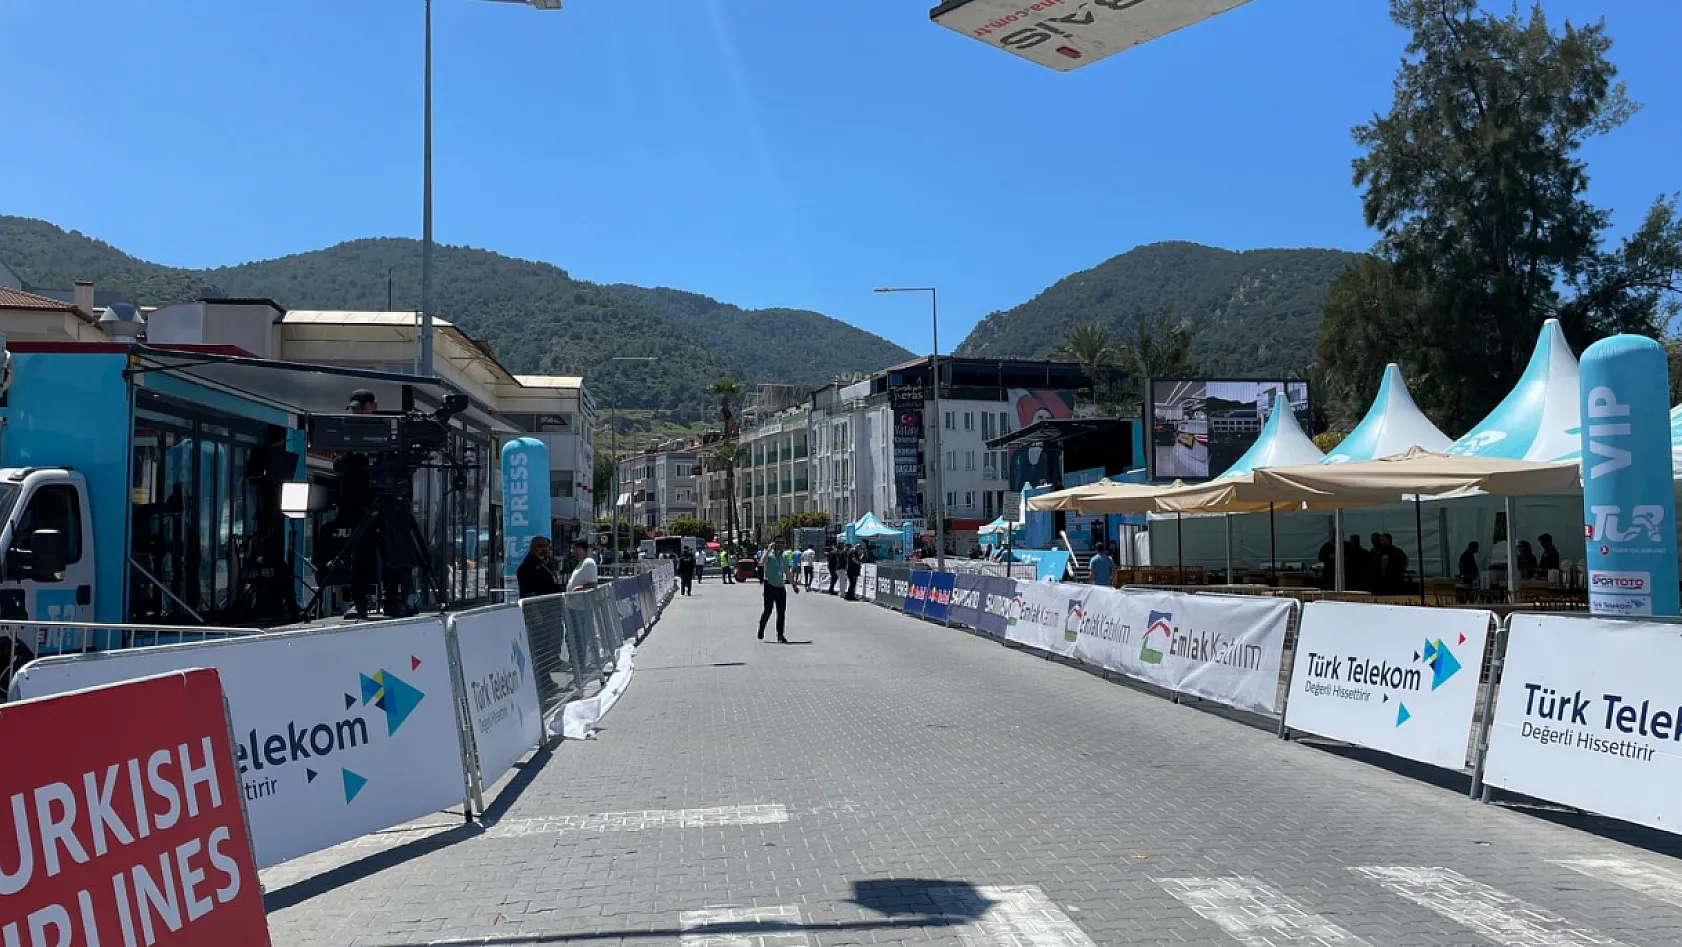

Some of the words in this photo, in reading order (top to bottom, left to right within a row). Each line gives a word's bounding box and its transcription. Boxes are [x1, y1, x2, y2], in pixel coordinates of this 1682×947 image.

[1588, 386, 1631, 480] VIP
[510, 452, 529, 527] PRESS
[1308, 652, 1341, 680] Türk
[1347, 656, 1421, 691] Telekom
[1525, 682, 1591, 726] Türk
[1521, 721, 1574, 746] Değerli
[1576, 731, 1656, 762] Hissettirir
[0, 736, 222, 895] URKISH
